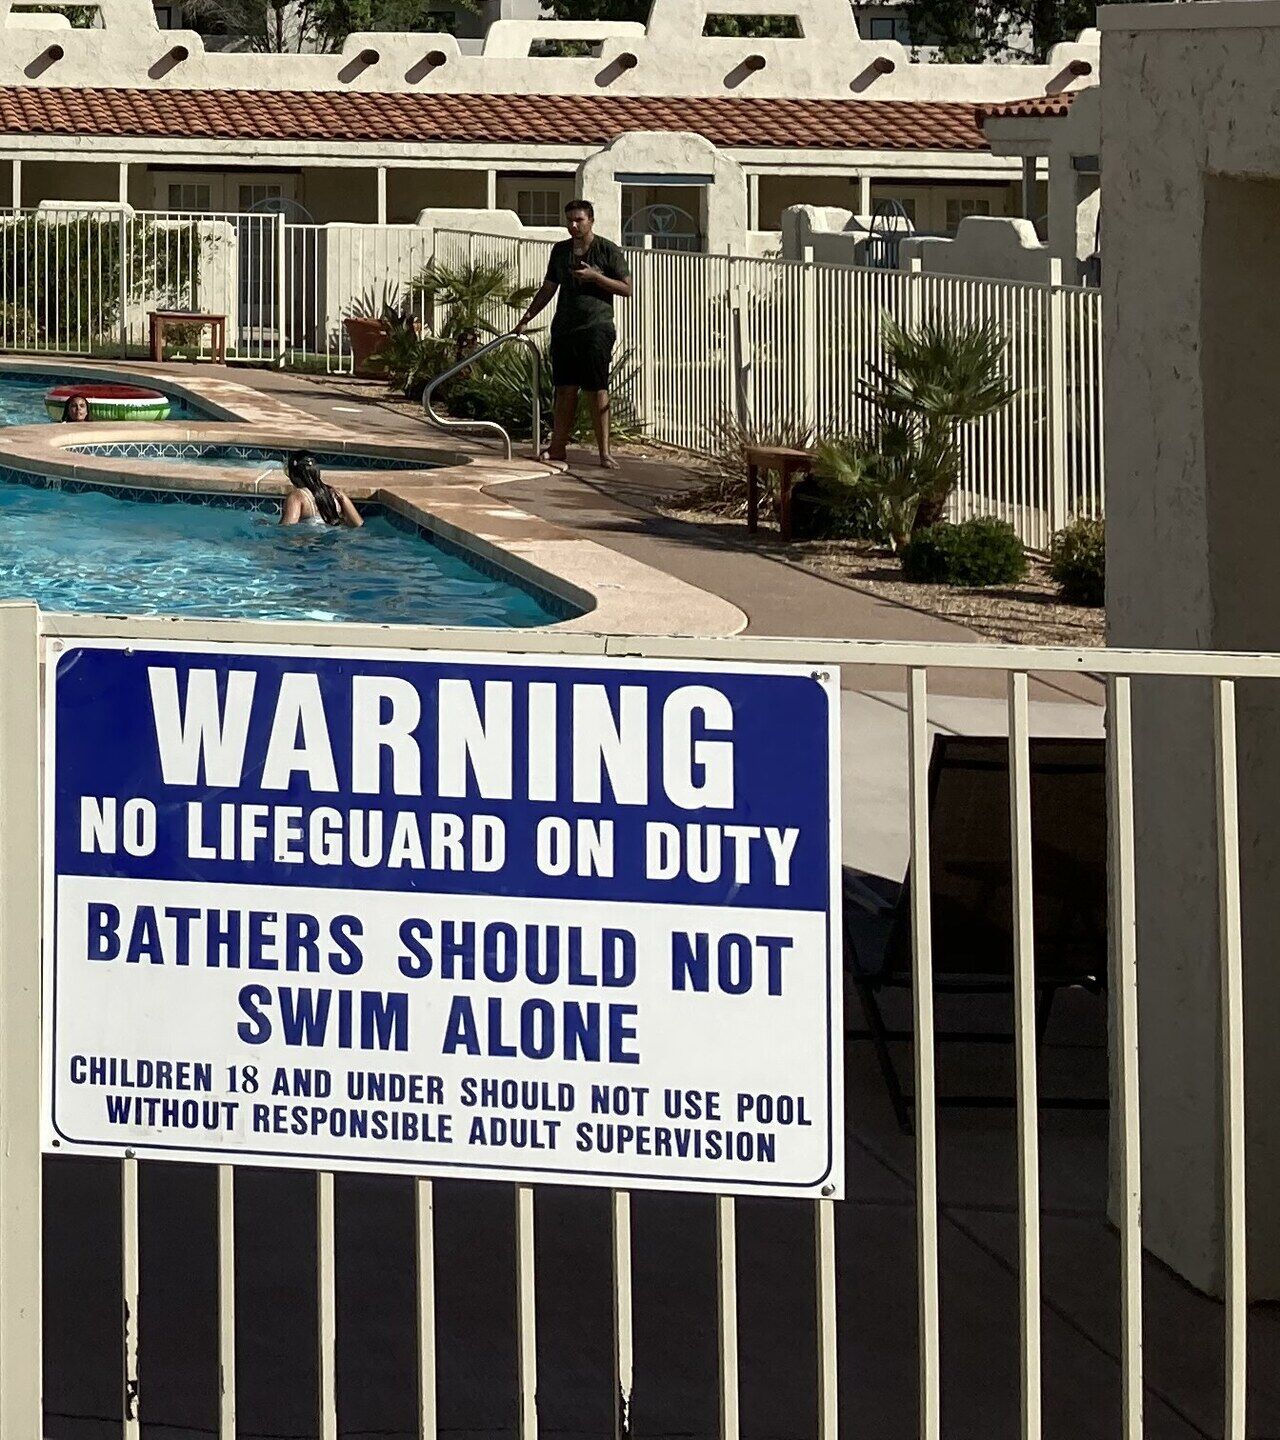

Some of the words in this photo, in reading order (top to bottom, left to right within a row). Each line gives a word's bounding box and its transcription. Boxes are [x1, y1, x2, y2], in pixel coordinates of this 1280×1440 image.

[148, 667, 733, 809] WARNING
[81, 796, 156, 856] NO
[188, 802, 505, 871] LIFEGUARD
[537, 817, 613, 877] ON
[647, 822, 799, 885] DUTY
[88, 903, 363, 975] BATHERS
[398, 918, 636, 987] SHOULD
[672, 932, 793, 996] NOT
[238, 985, 408, 1051] SWIM
[442, 996, 639, 1064] ALONE
[71, 1056, 211, 1091] CHILDREN
[228, 1066, 258, 1093] 18
[272, 1068, 331, 1097] AND
[348, 1072, 443, 1104] UNDER
[461, 1078, 574, 1111] SHOULD
[592, 1085, 649, 1116] NOT
[665, 1089, 720, 1120] USE
[738, 1094, 811, 1125] POOL
[106, 1095, 239, 1130] WITHOUT
[254, 1104, 452, 1143] RESPONSIBLE
[469, 1117, 561, 1149] ADULT
[577, 1123, 775, 1162] SUPERVISION
